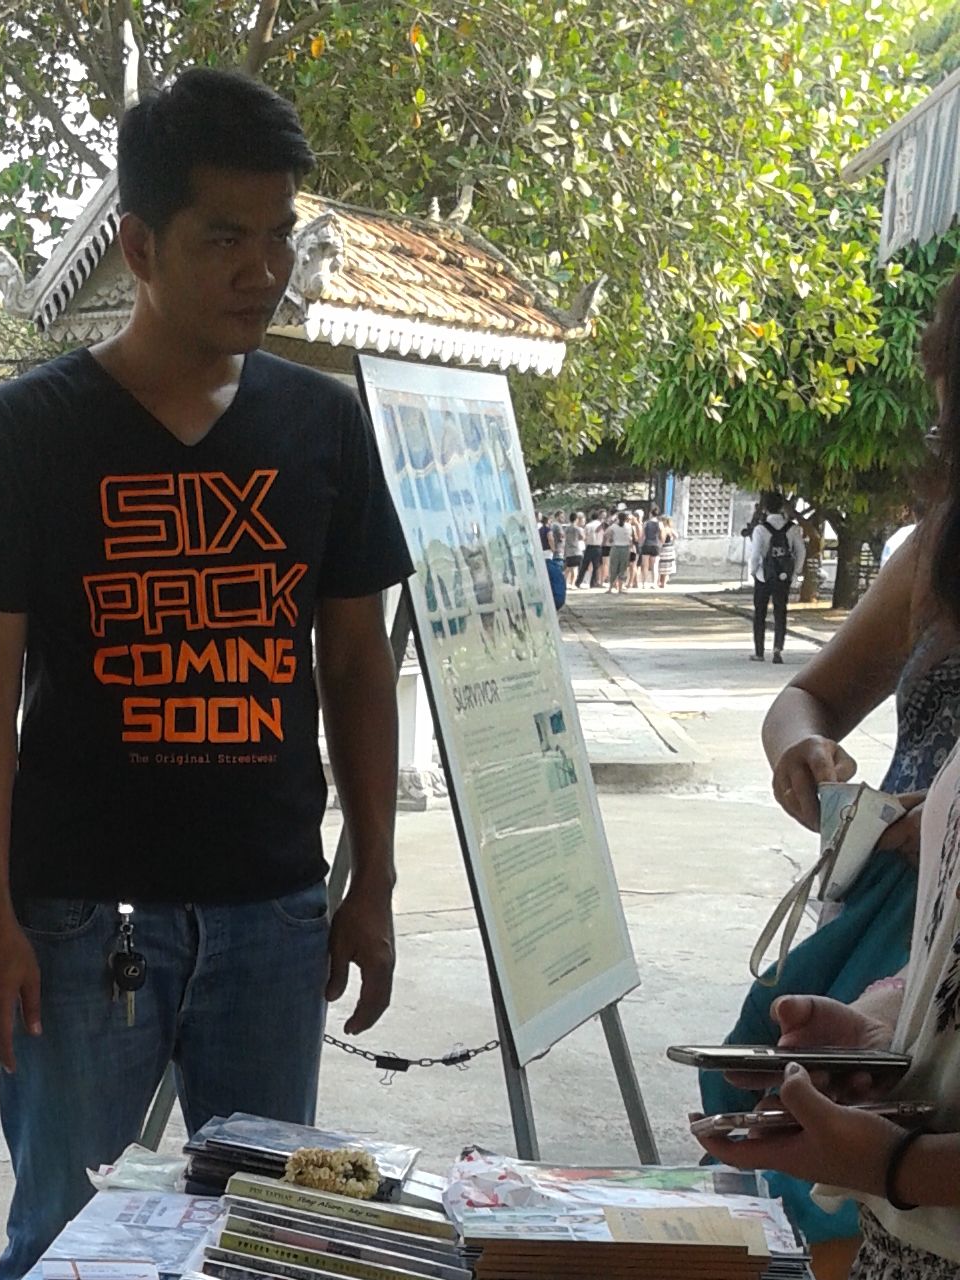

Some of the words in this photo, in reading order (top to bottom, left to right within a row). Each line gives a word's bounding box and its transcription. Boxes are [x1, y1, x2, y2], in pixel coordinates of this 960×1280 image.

[100, 469, 288, 560] SIX
[82, 563, 309, 637] PACK
[93, 636, 297, 686] COMING
[121, 695, 284, 743] SOON
[452, 679, 501, 712] SURVIVOR
[129, 753, 149, 764] The
[155, 753, 211, 766] Original
